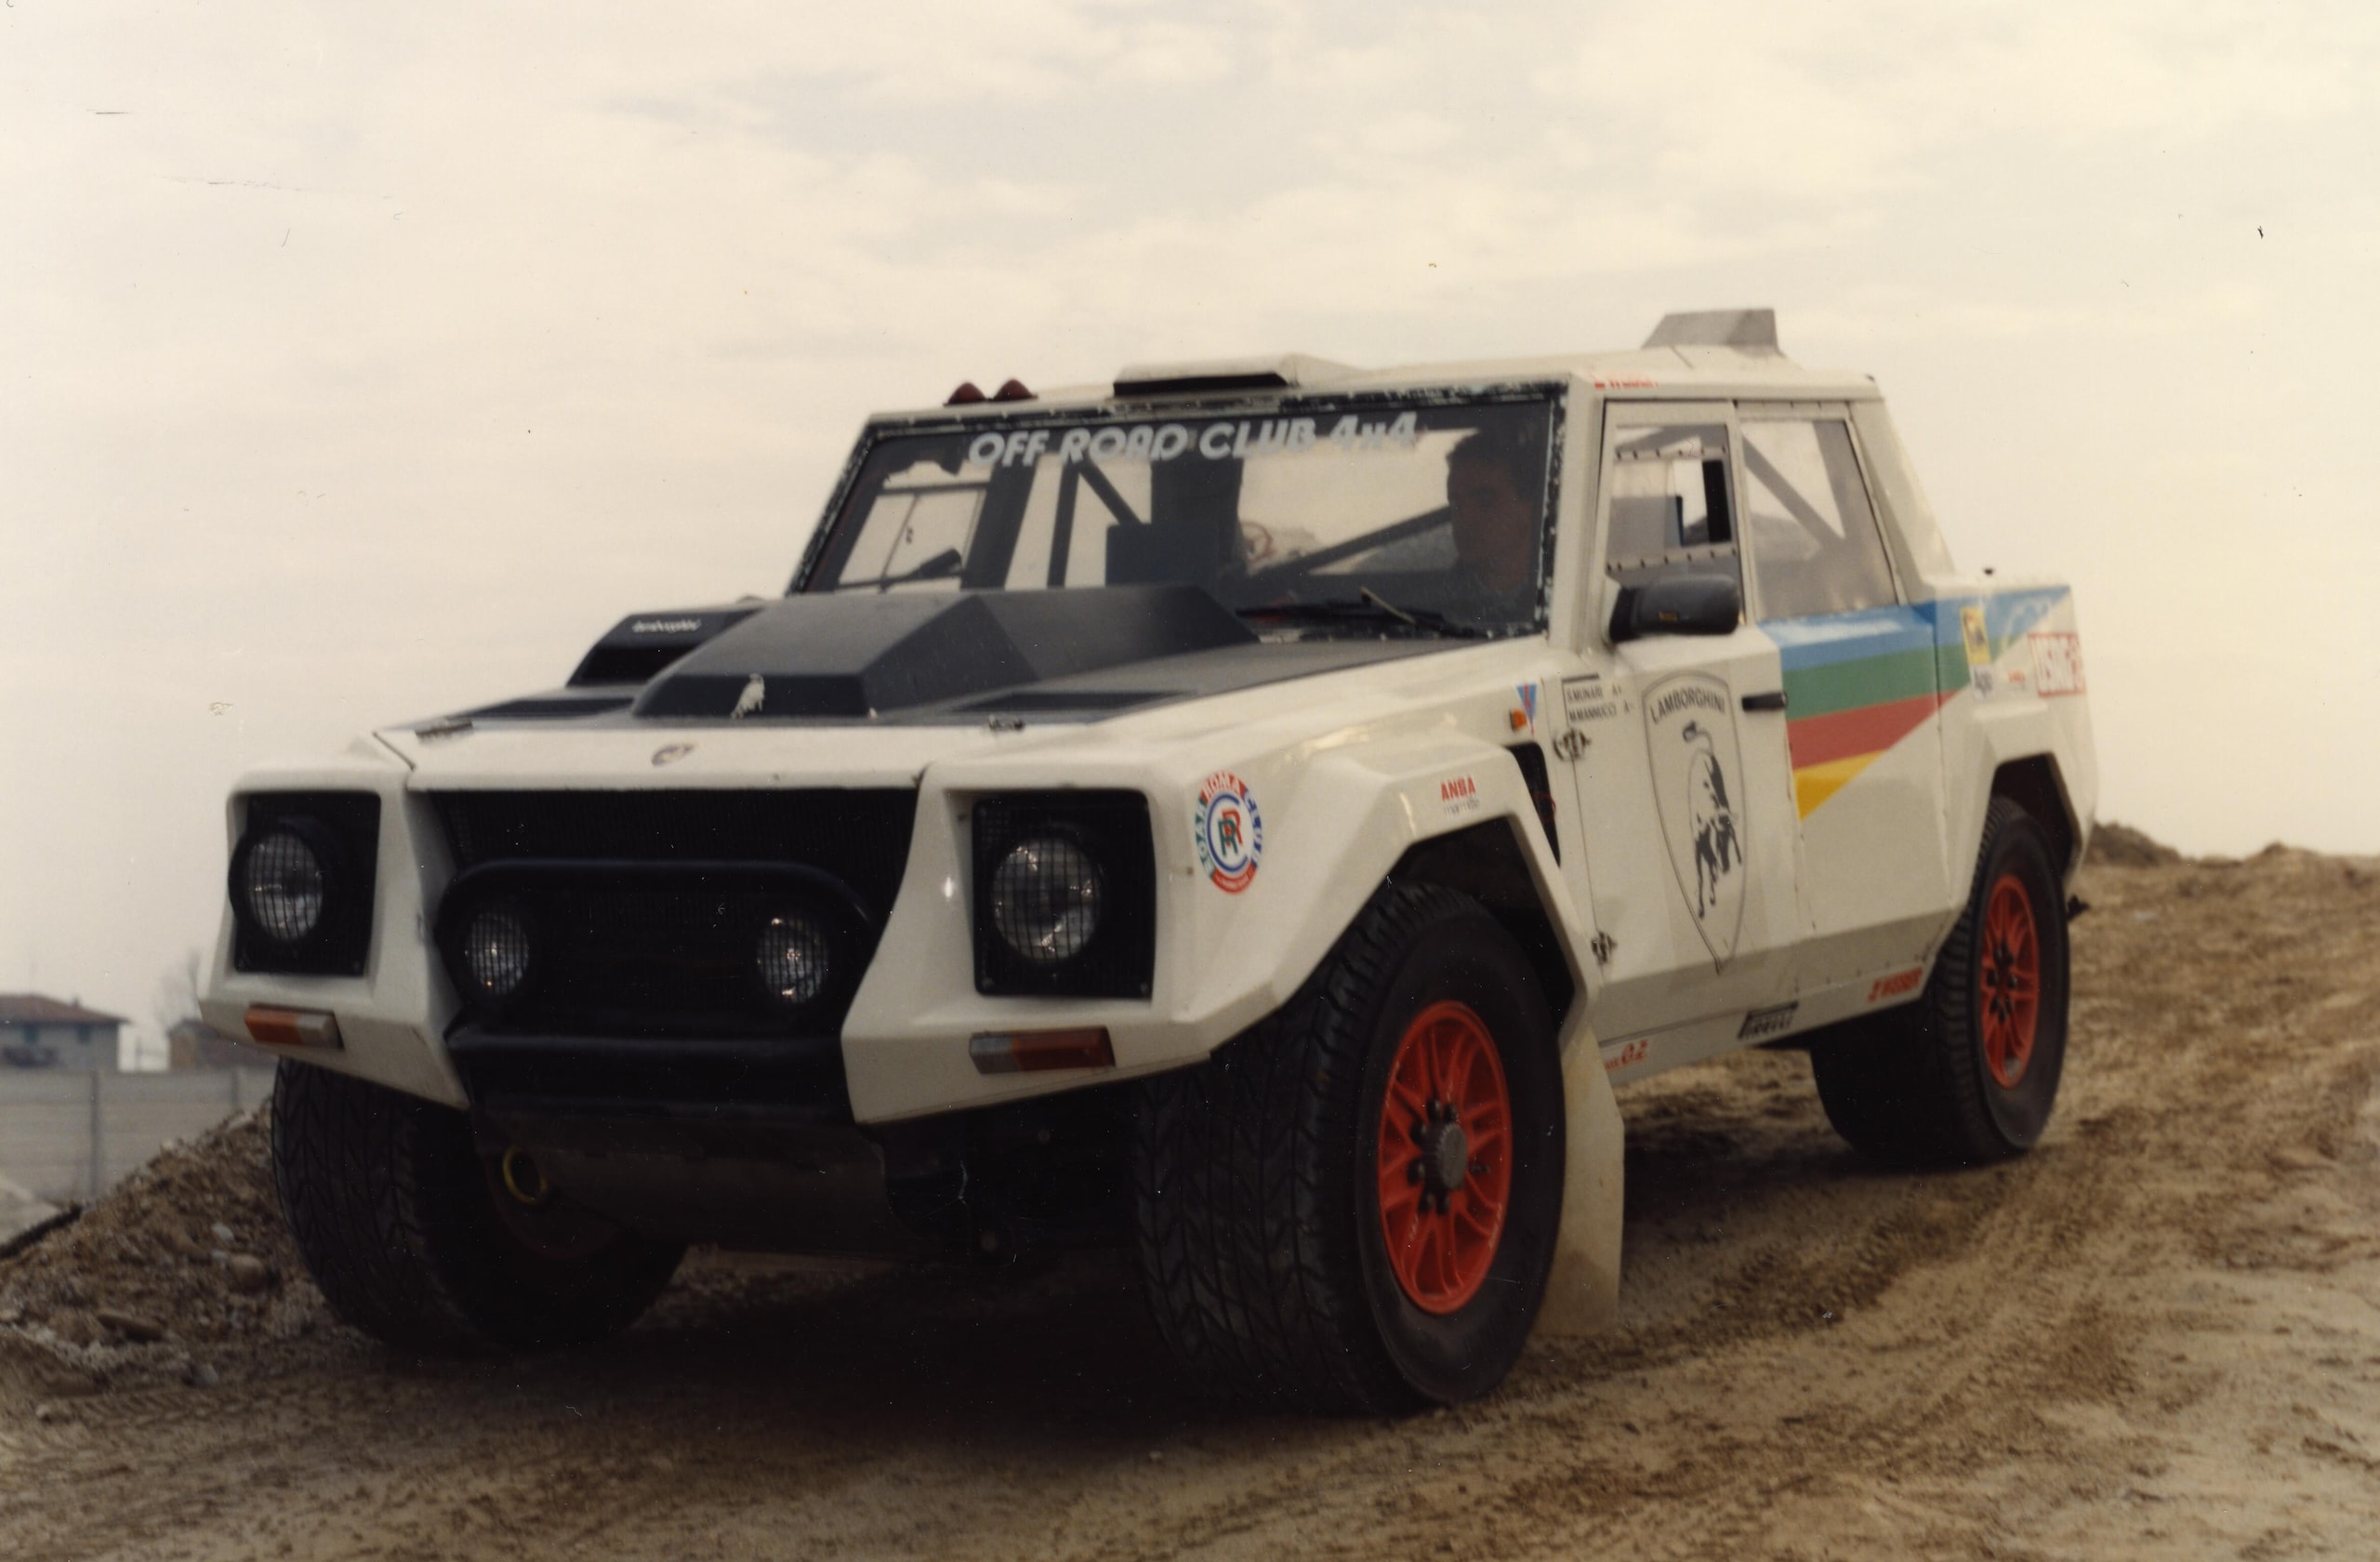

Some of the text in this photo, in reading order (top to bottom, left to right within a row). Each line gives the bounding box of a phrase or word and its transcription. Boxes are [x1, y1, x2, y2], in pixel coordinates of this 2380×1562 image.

[968, 430, 1051, 468] OFF
[1060, 423, 1188, 465] ROAD
[1199, 417, 1317, 460] CLUB
[1649, 686, 1726, 725] LAMBORGHINI
